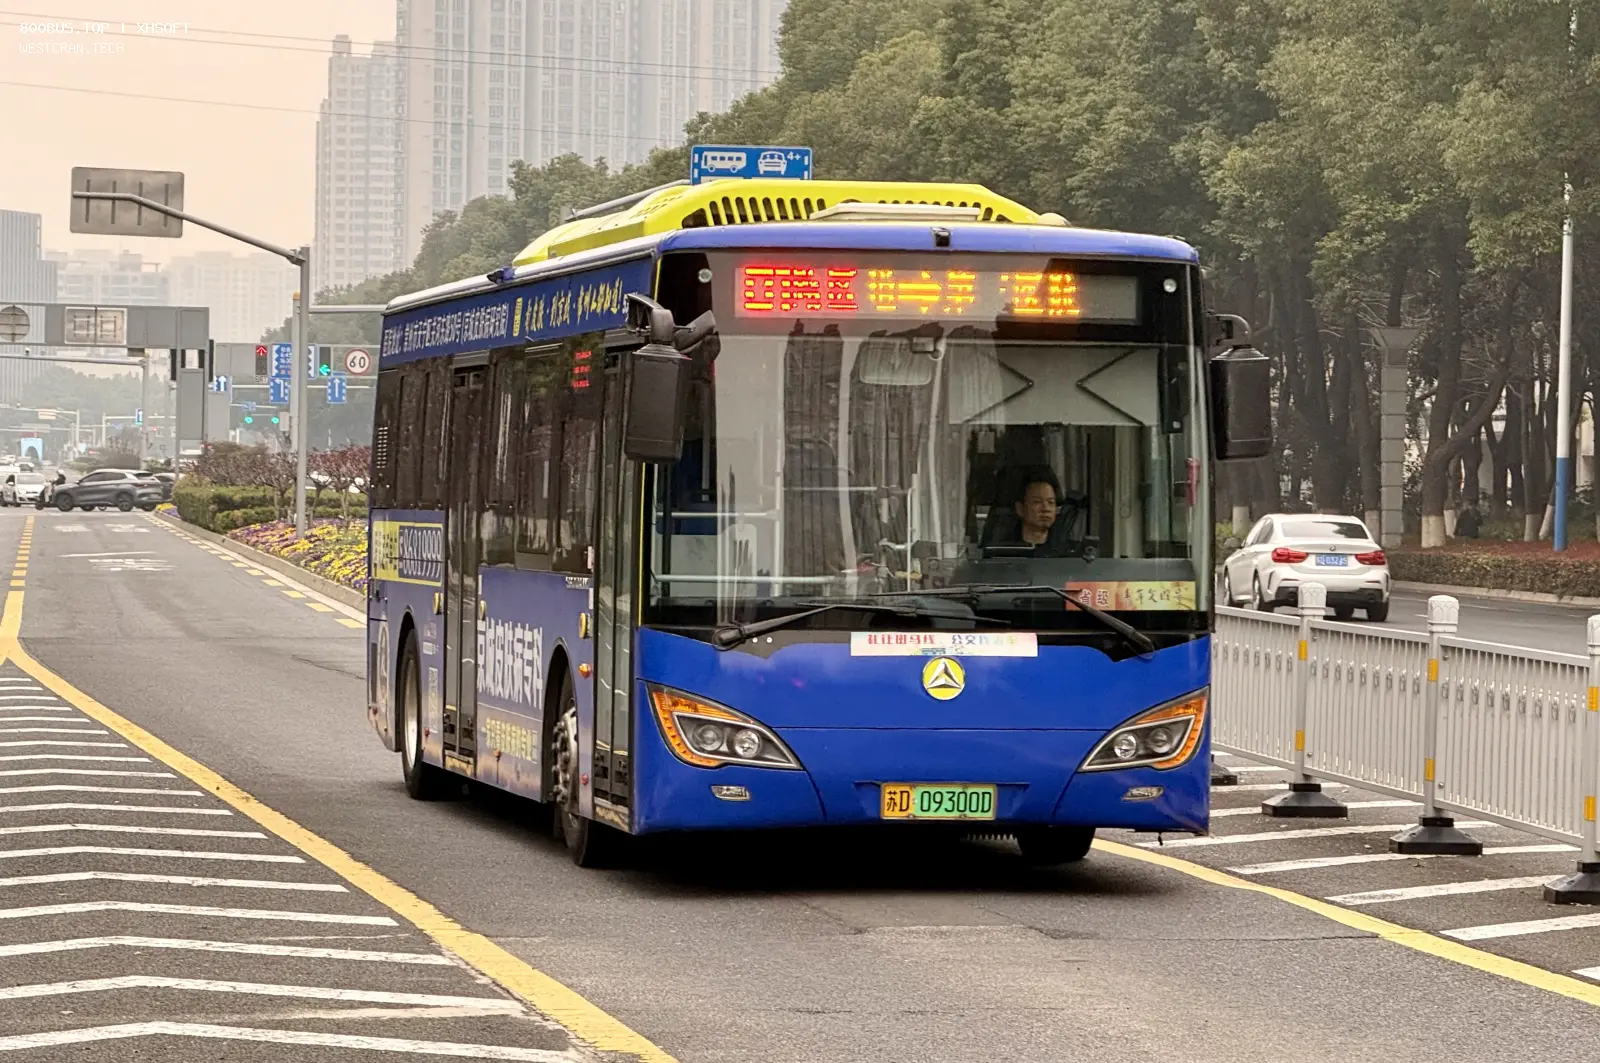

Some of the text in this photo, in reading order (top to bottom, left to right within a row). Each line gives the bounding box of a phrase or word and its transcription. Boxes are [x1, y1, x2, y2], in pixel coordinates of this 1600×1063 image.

[348, 356, 366, 369] 60
[866, 633, 937, 646] 礼让斑马线
[886, 789, 993, 813] 苏D 09300D
